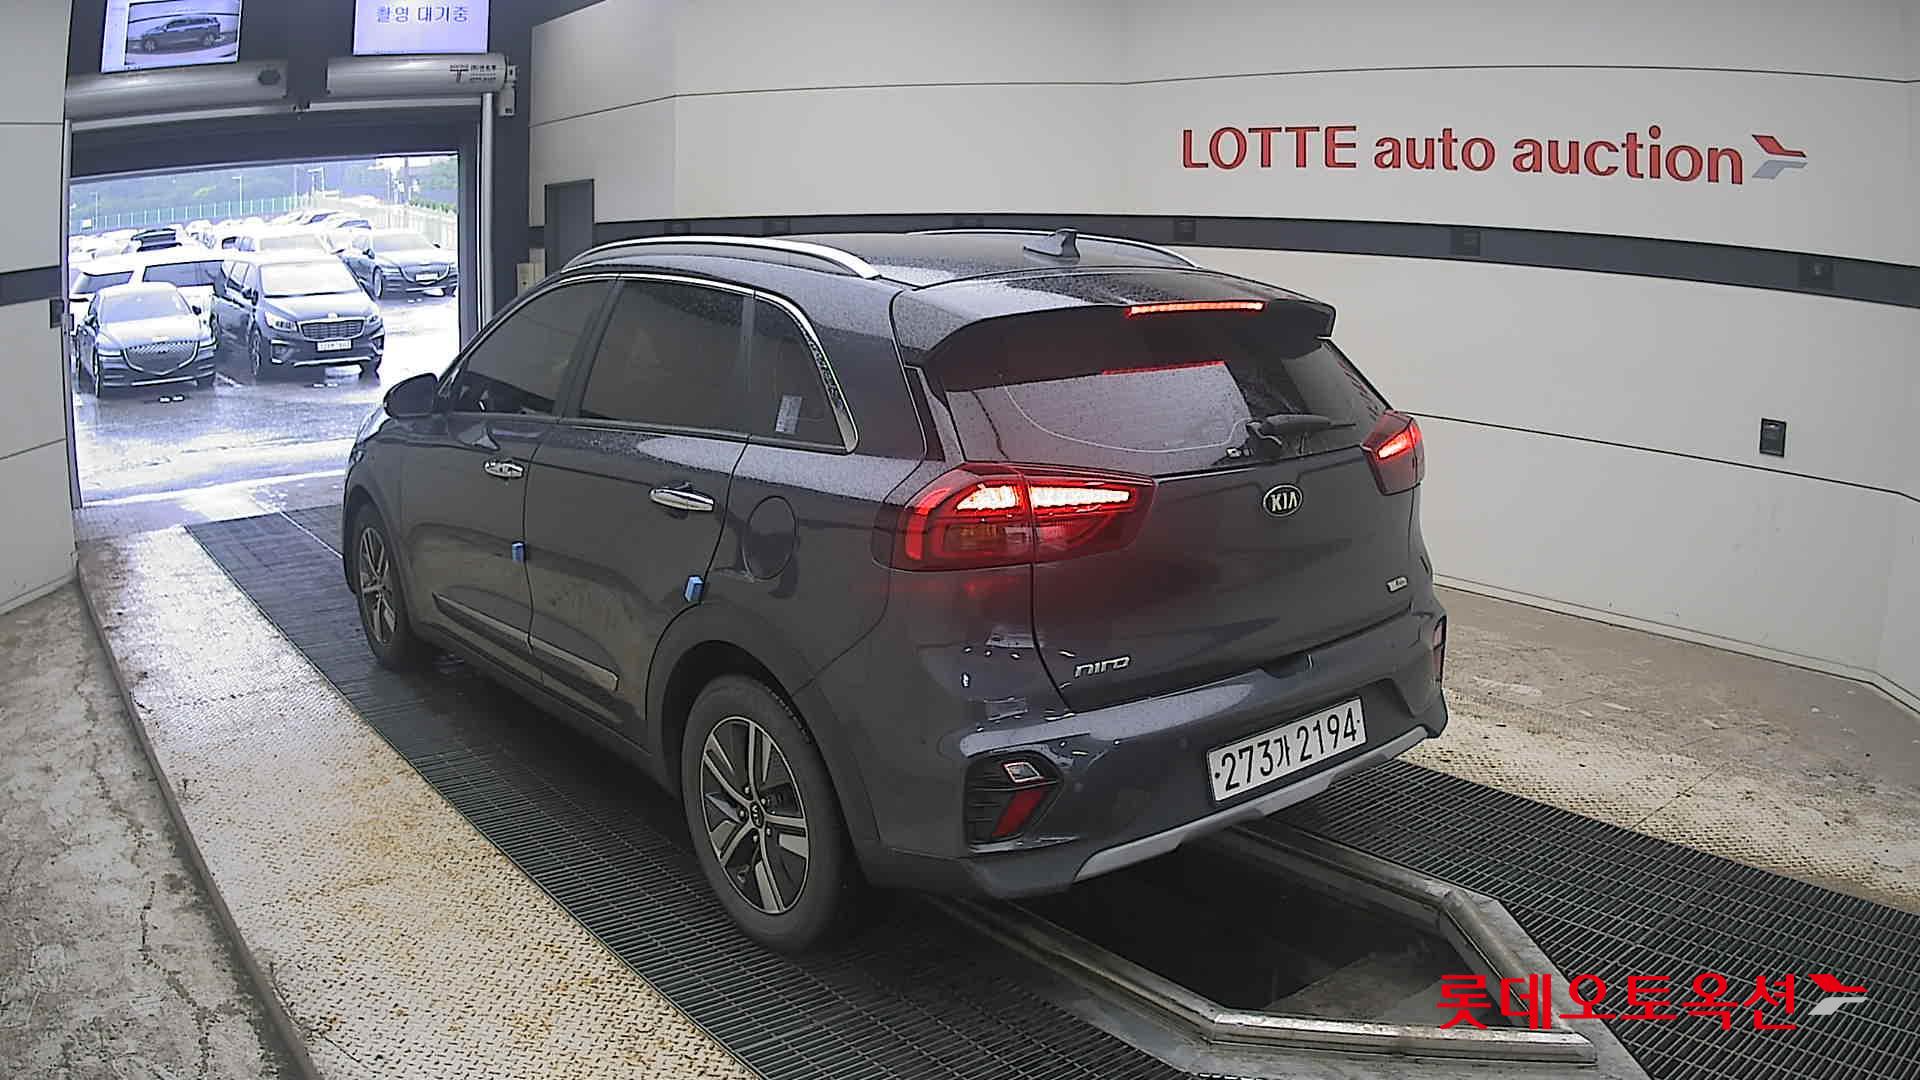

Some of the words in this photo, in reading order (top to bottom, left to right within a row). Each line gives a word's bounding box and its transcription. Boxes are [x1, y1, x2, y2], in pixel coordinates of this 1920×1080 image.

[417, 6, 469, 23] 대기중
[1183, 126, 1357, 169] LOTTE
[1374, 128, 1496, 171] auto
[1512, 125, 1743, 184] auction
[1270, 491, 1298, 512] KIA
[1221, 734, 1290, 792] 273가
[1297, 707, 1357, 762] 2194
